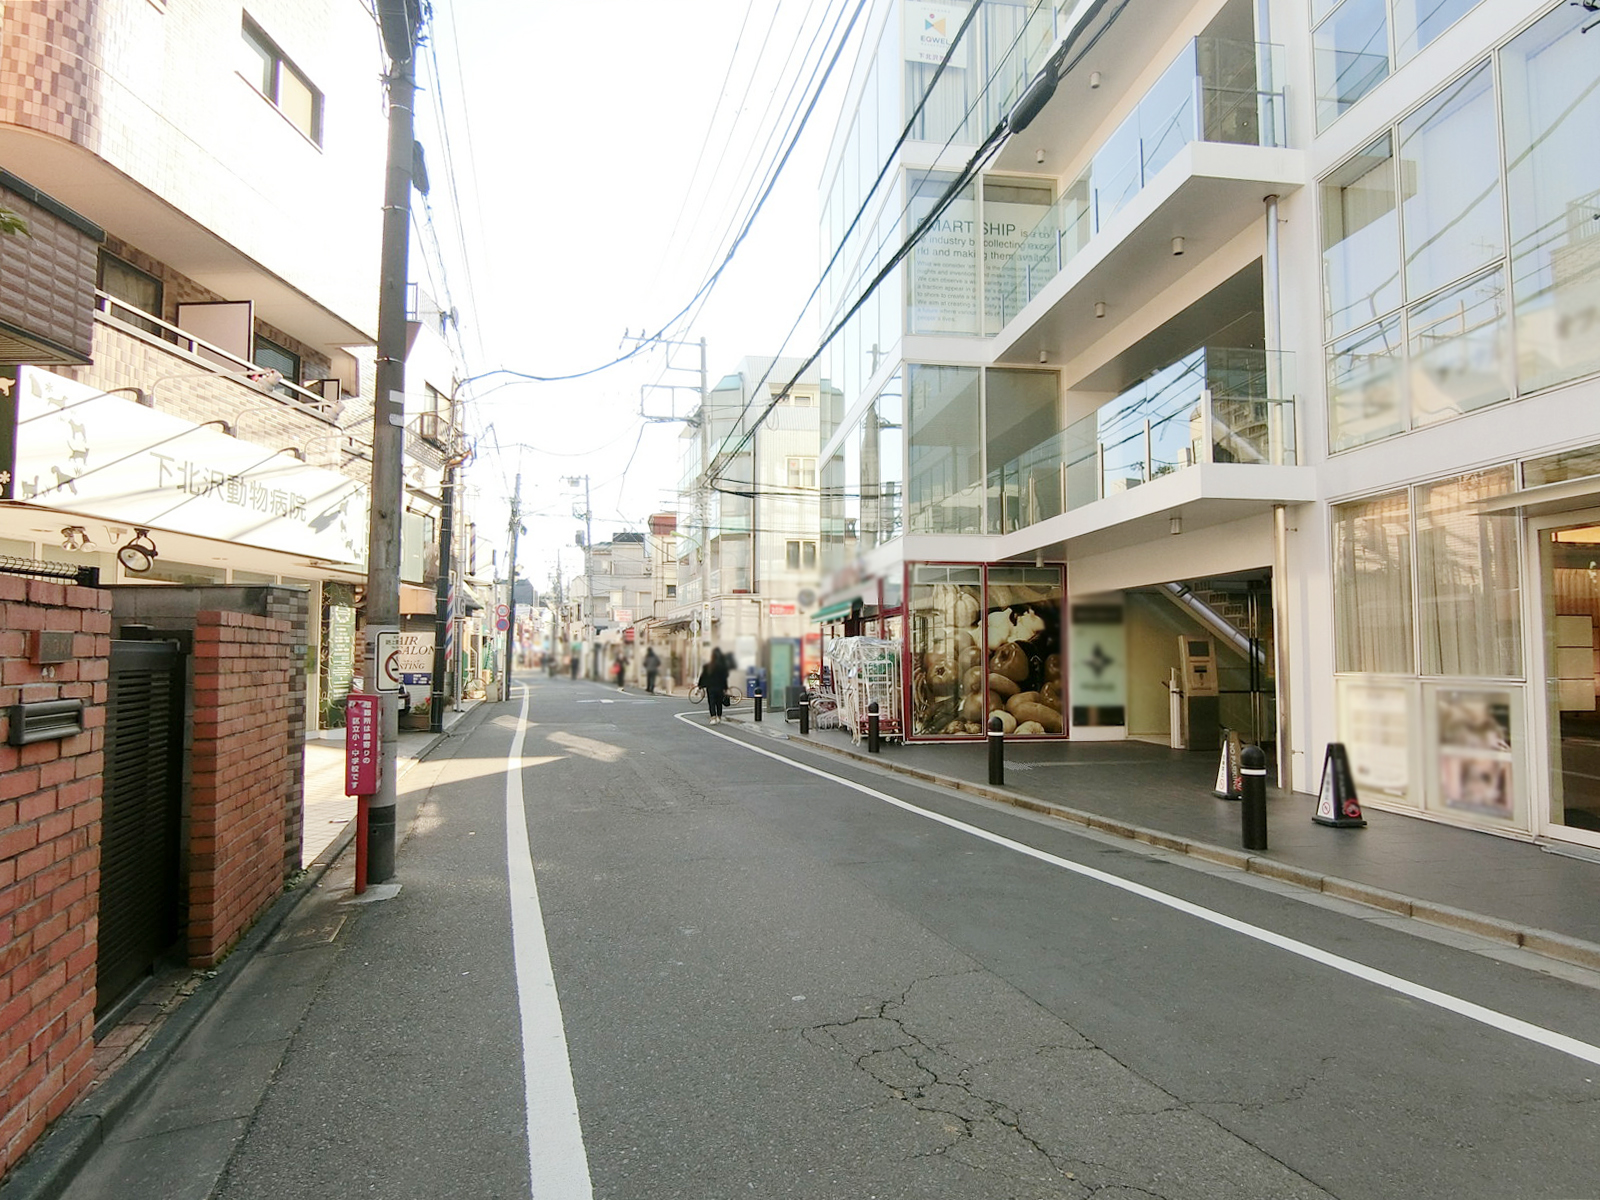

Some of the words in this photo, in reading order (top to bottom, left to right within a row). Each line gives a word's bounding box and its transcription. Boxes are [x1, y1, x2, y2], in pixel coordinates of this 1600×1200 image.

[929, 234, 966, 246] industry
[933, 249, 950, 257] and
[150, 451, 307, 522] 下北沢動物病院
[1229, 742, 1236, 755] NO
